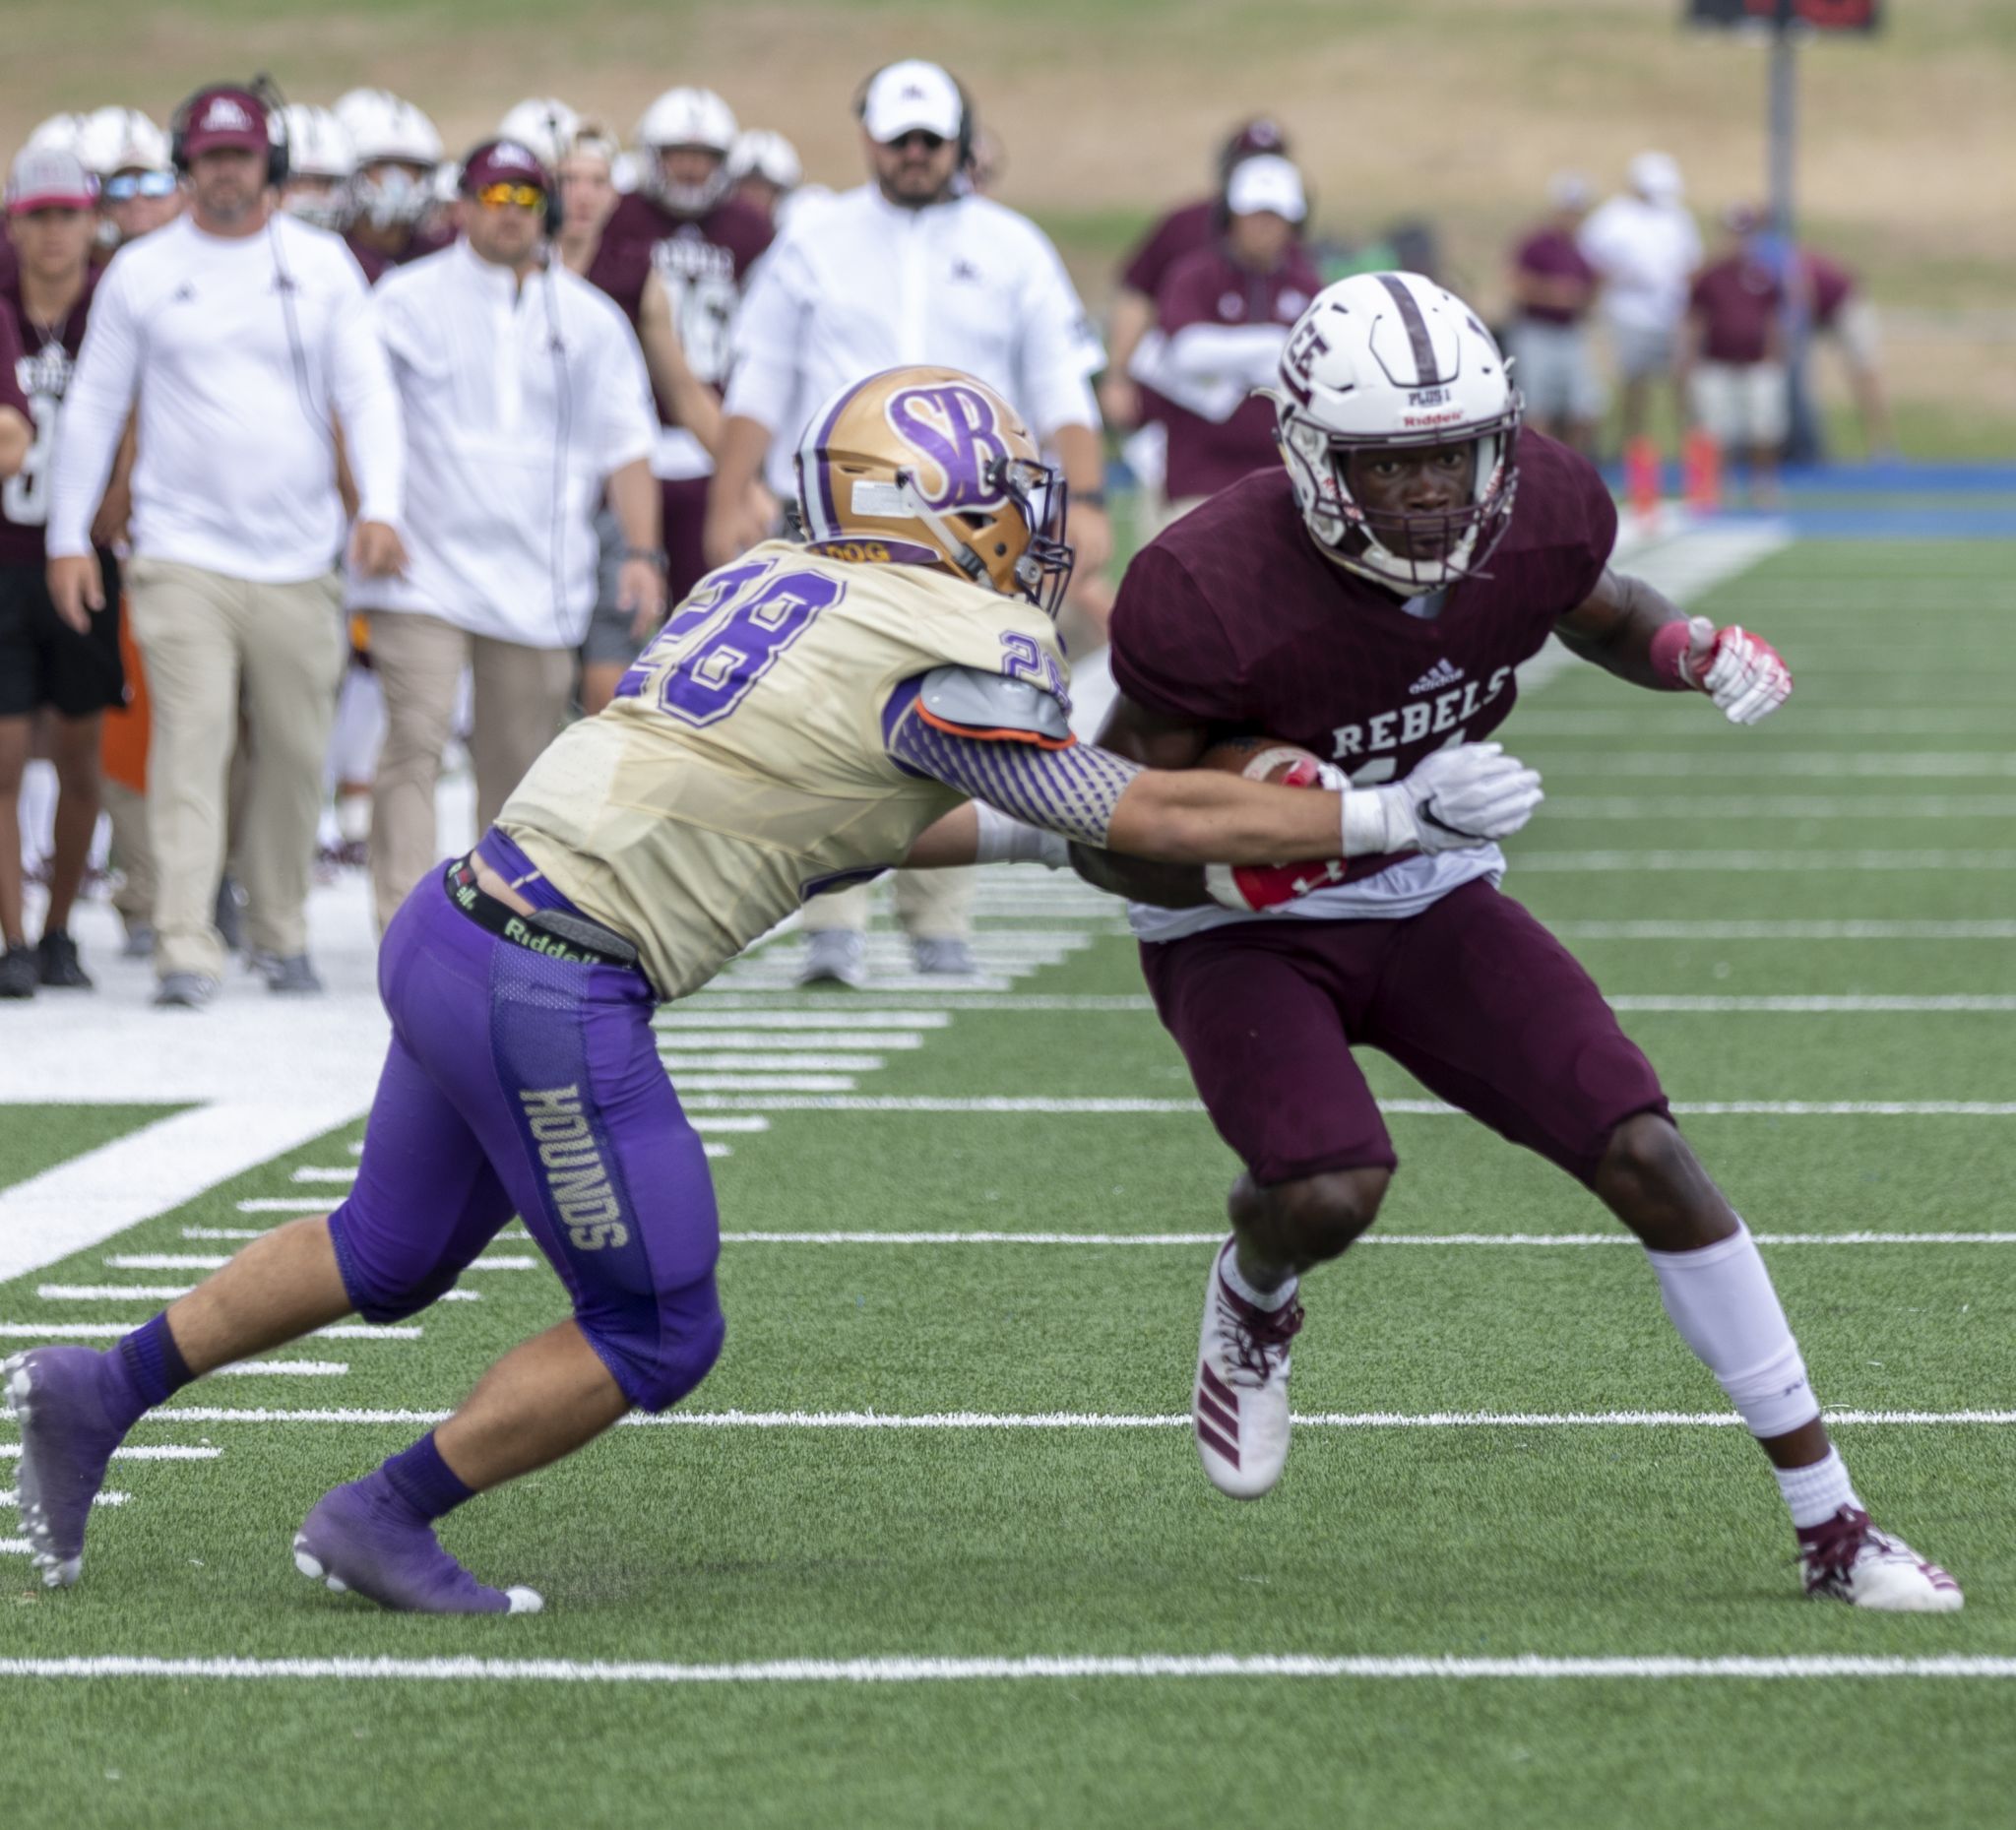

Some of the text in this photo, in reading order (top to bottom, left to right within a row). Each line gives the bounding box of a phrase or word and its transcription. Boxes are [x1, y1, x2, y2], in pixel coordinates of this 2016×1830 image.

[885, 380, 1016, 515] SB
[614, 557, 848, 729] 28
[1332, 664, 1512, 760] REBELS
[519, 1083, 630, 1252] HOUNDS
